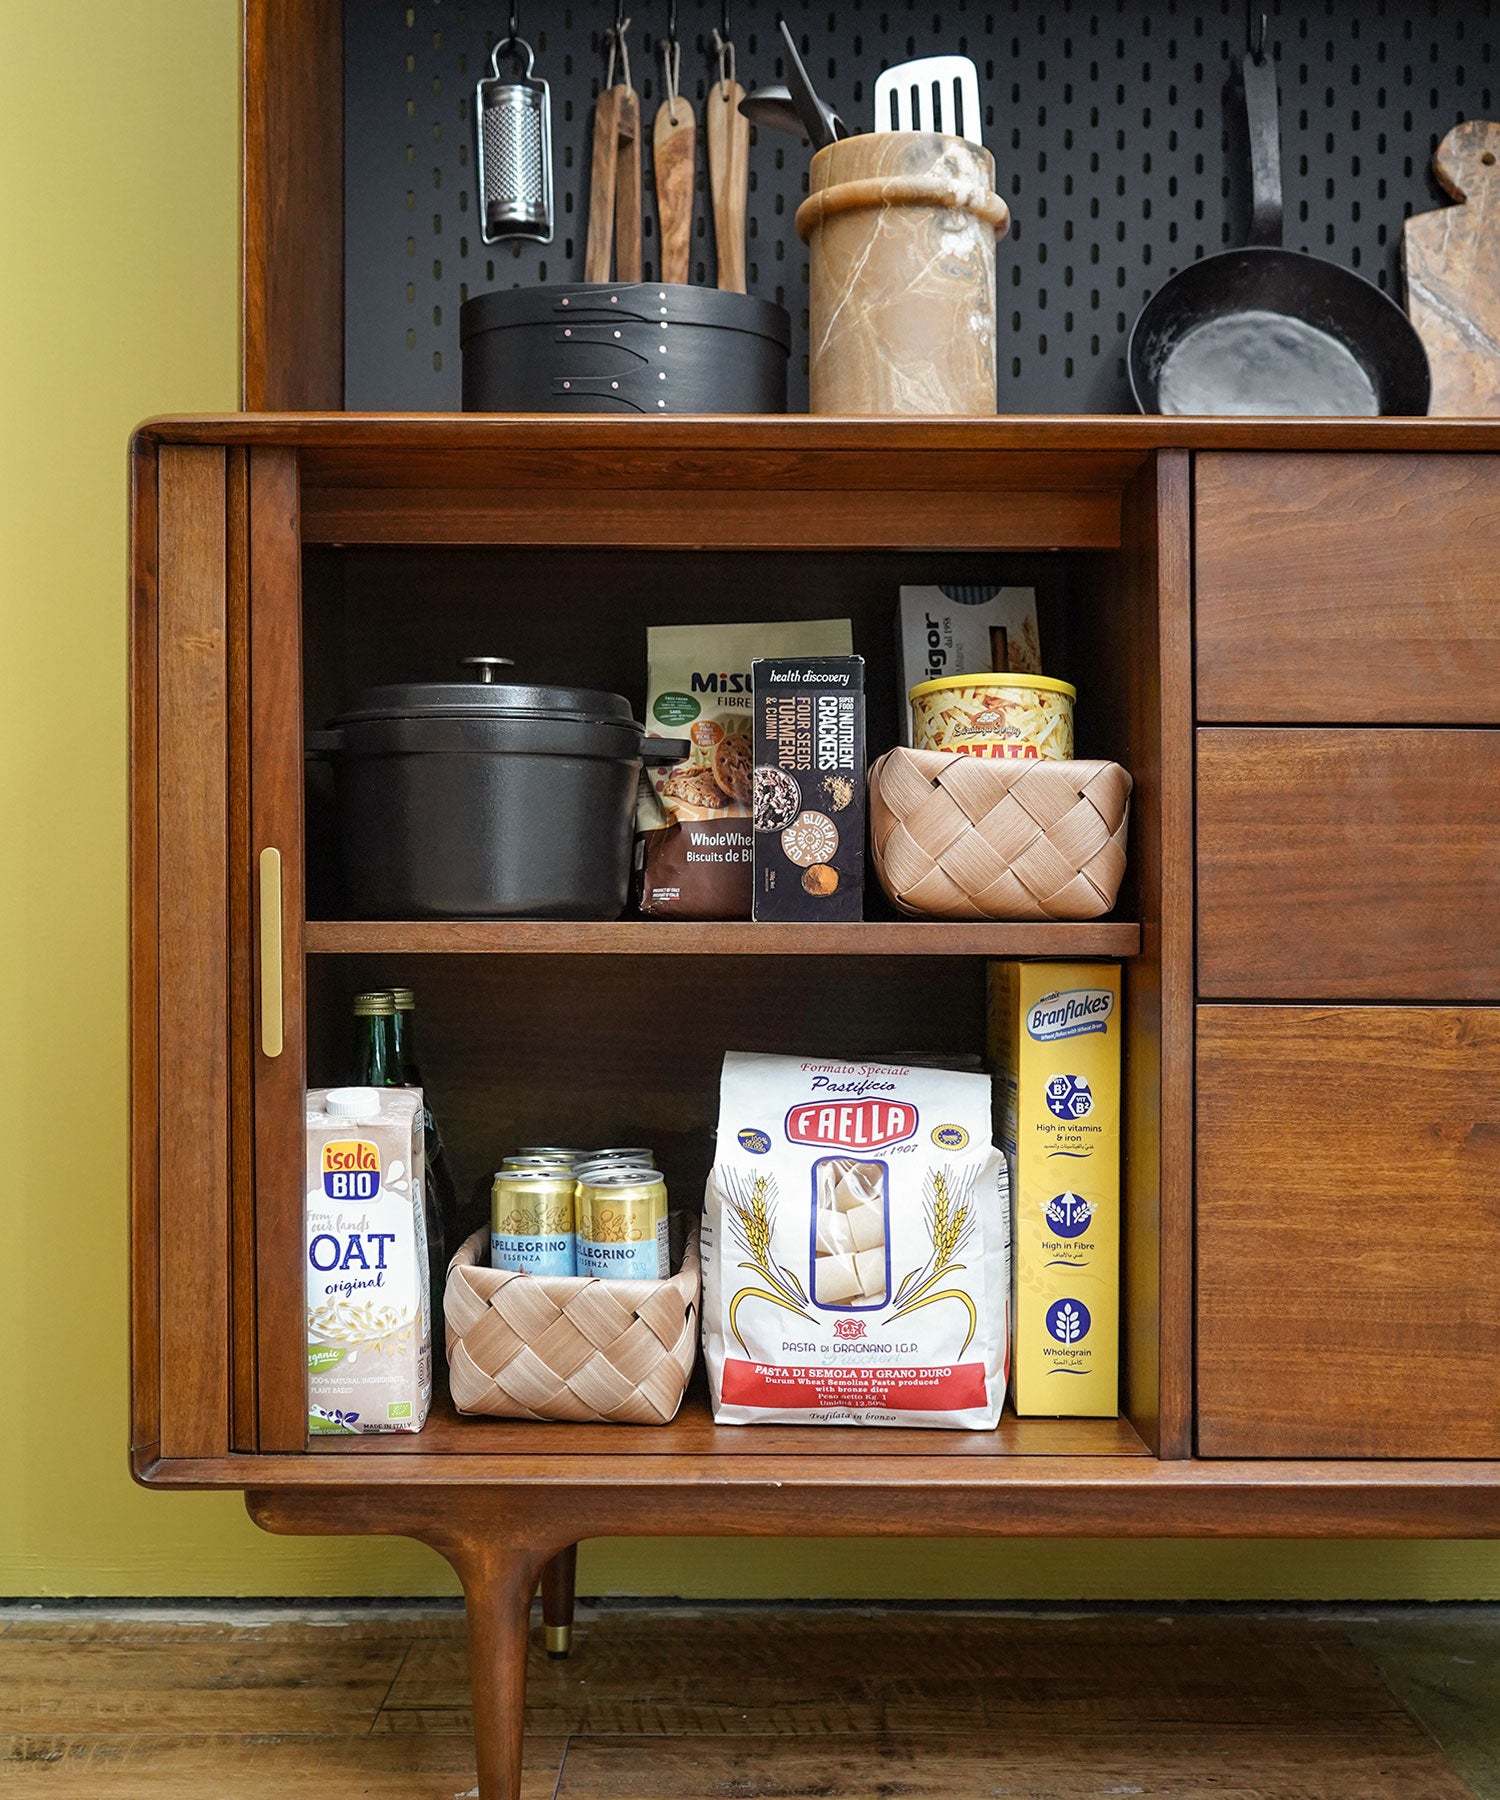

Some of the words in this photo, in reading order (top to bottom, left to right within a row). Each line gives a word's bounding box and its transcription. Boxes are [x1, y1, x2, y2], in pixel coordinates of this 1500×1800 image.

[925, 612, 947, 680] igor
[770, 669, 801, 683] health
[802, 669, 850, 686] discovery
[717, 696, 752, 708] FIBRE
[765, 697, 777, 705] &
[796, 697, 811, 729] FOUR
[765, 707, 777, 740] CUMIN
[778, 696, 796, 770] TURMERIC
[818, 696, 838, 770] CRACKERS
[838, 712, 854, 770] NUTRIENT
[796, 732, 811, 770] SEEDS
[940, 744, 1038, 759] TATO
[803, 813, 836, 838] GLUTEN
[783, 828, 803, 861] PALEO
[813, 840, 836, 864] FREE
[686, 851, 723, 862] Biscuits
[724, 849, 740, 862] de
[1032, 995, 1110, 1030] Branflakes
[800, 1062, 855, 1075] Formato
[858, 1064, 910, 1078] Speciale
[811, 1075, 897, 1095] Pastificio
[798, 1104, 905, 1144] FAELLA
[1036, 1124, 1056, 1133] High
[1058, 1124, 1066, 1132] in
[1067, 1124, 1102, 1132] vitamins
[1064, 1134, 1082, 1142] iron
[326, 1143, 377, 1170] isola
[890, 1144, 918, 1155] 1907
[332, 1172, 372, 1197] BIO
[311, 1220, 335, 1232] our
[336, 1213, 370, 1233] lands
[309, 1233, 395, 1271] OAT
[1042, 1241, 1062, 1251] High
[1063, 1241, 1072, 1249] in
[1074, 1241, 1095, 1250] Fibre
[503, 1253, 541, 1262] ESSENZA
[325, 1271, 386, 1298] original
[782, 1341, 816, 1352] PASTA
[833, 1343, 892, 1353] GRAGNANO
[895, 1343, 918, 1353] I.G.P.
[1043, 1348, 1092, 1357] Wholegrain
[754, 1365, 788, 1377] PASTA
[792, 1368, 805, 1377] DI
[808, 1368, 857, 1378] SEMOLA
[860, 1369, 874, 1378] DI
[876, 1369, 918, 1378] GRANO
[919, 1368, 952, 1378] DURO
[311, 1377, 330, 1385] 100%
[329, 1377, 361, 1385] NATURAL
[827, 1378, 869, 1386] Semolina
[897, 1378, 940, 1387] produced
[809, 1411, 851, 1421] Trafilata
[853, 1412, 863, 1421] in
[865, 1412, 897, 1421] bronzo
[393, 1422, 413, 1430] ITALY
